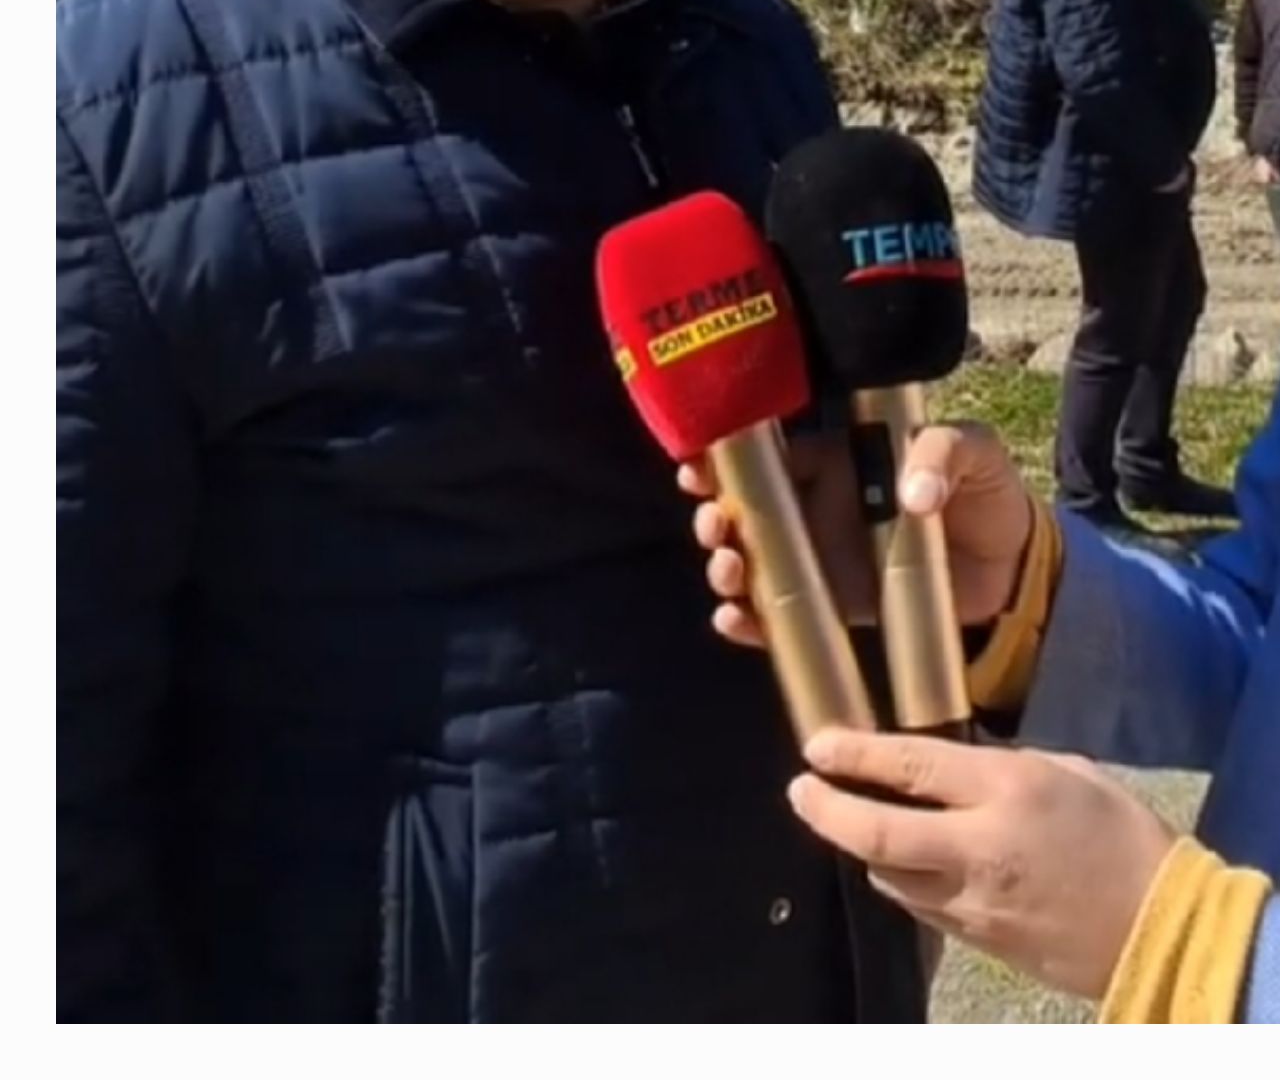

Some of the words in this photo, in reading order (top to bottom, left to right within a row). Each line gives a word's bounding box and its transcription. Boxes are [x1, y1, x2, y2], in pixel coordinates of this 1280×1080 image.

[841, 221, 957, 269] TEMP
[644, 267, 763, 333] TERME
[652, 328, 694, 359] SON
